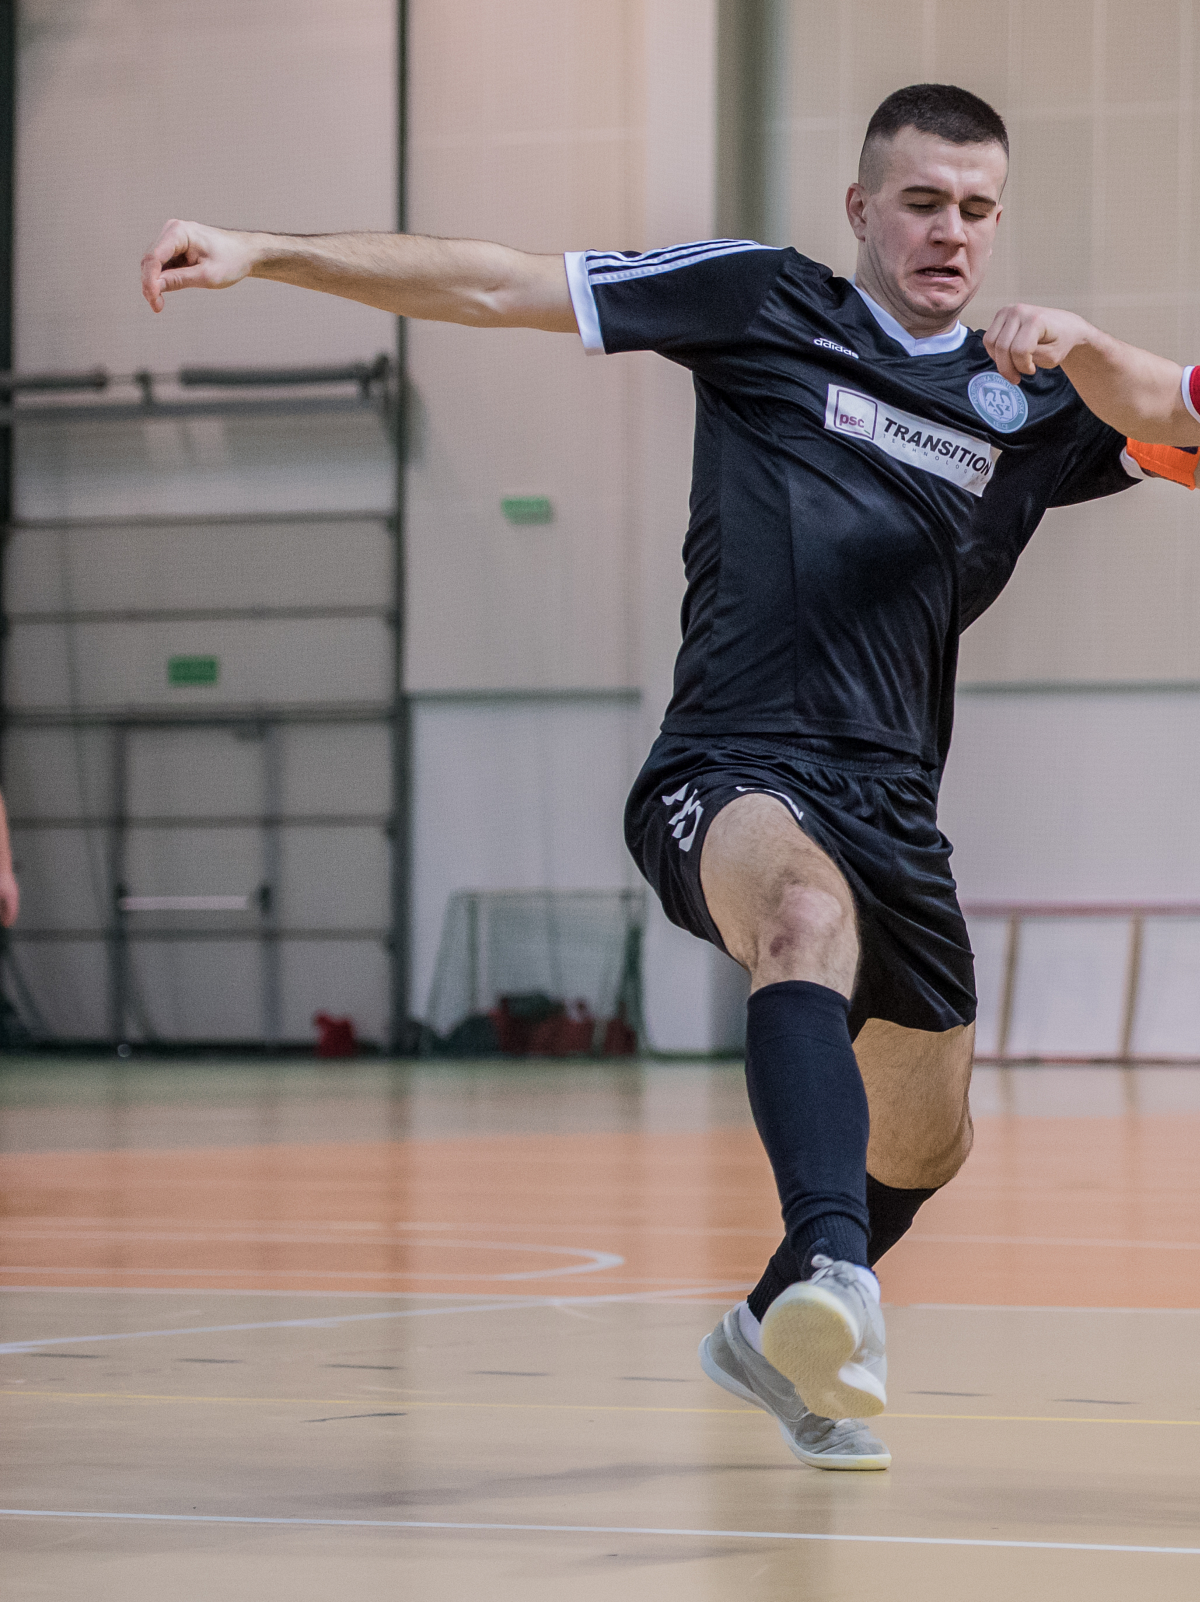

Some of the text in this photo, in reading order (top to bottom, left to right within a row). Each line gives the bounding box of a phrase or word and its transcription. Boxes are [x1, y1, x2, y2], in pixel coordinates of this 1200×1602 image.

[813, 337, 859, 360] adidas
[839, 413, 865, 429] psc
[883, 417, 993, 476] TRANSITION
